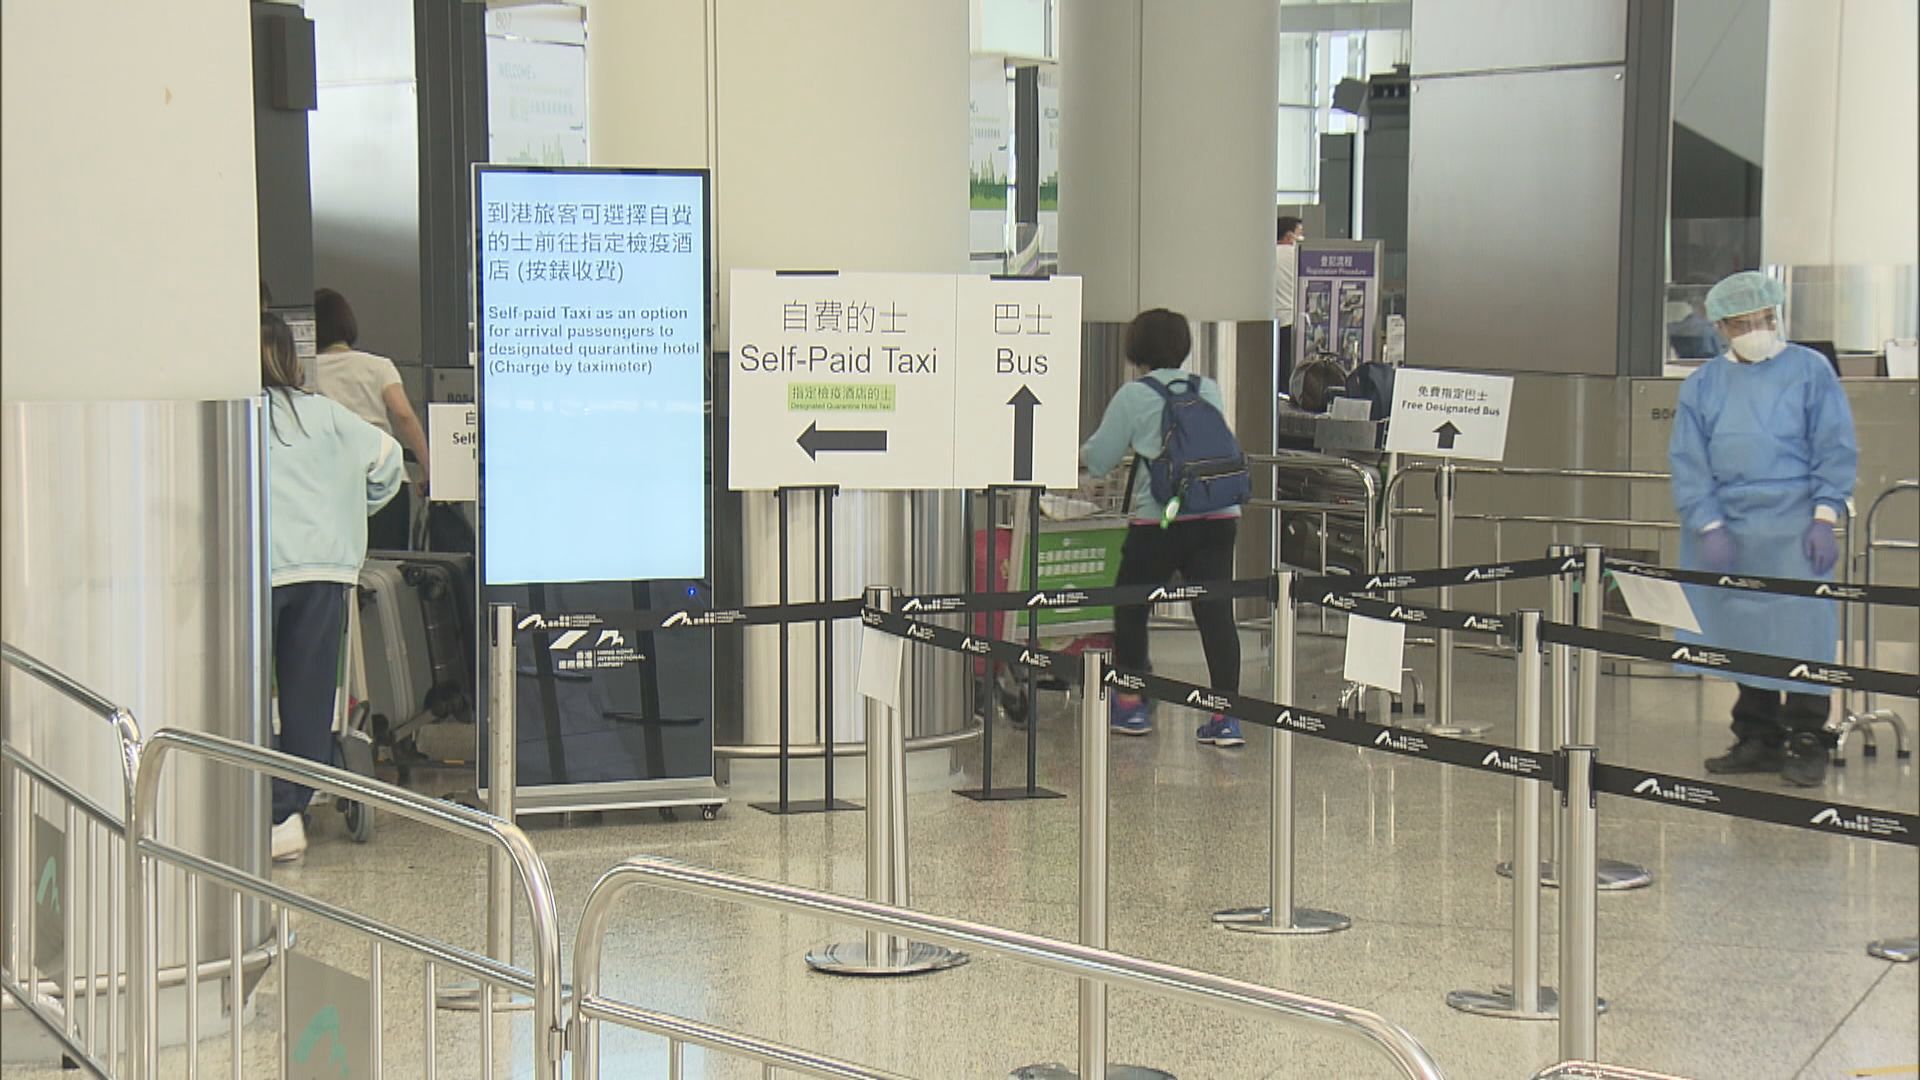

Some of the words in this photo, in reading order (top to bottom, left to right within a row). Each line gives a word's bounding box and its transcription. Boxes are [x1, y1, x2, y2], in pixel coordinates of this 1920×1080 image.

[488, 202, 692, 226] 到港旅客可選擇自費
[488, 231, 692, 254] 的士前往指定檢疫酒
[488, 260, 509, 281] 店
[518, 260, 624, 283] (按錶收費)
[488, 306, 556, 320] Self-paid
[561, 307, 592, 319] Taxi
[596, 309, 613, 320] as
[618, 309, 636, 320] an
[640, 307, 688, 324] option
[783, 300, 908, 334] 自費的士
[994, 303, 1052, 335] 巴士
[488, 325, 509, 337] for
[514, 325, 563, 337] arrival
[567, 326, 655, 340] passengers
[659, 325, 674, 337] to
[489, 342, 573, 357] designated
[578, 342, 658, 357] quarantine
[662, 341, 700, 355] hotel
[740, 344, 872, 374] Self-Paid
[881, 346, 938, 374] Taxi
[489, 360, 550, 376] (Charge
[554, 360, 573, 375] by
[577, 360, 653, 376] taximeter)
[995, 347, 1049, 375] Bus
[1418, 385, 1489, 402] 免費指定巴士
[1402, 399, 1423, 410] Free
[1425, 401, 1480, 415] Designated
[1482, 406, 1501, 417] Bus
